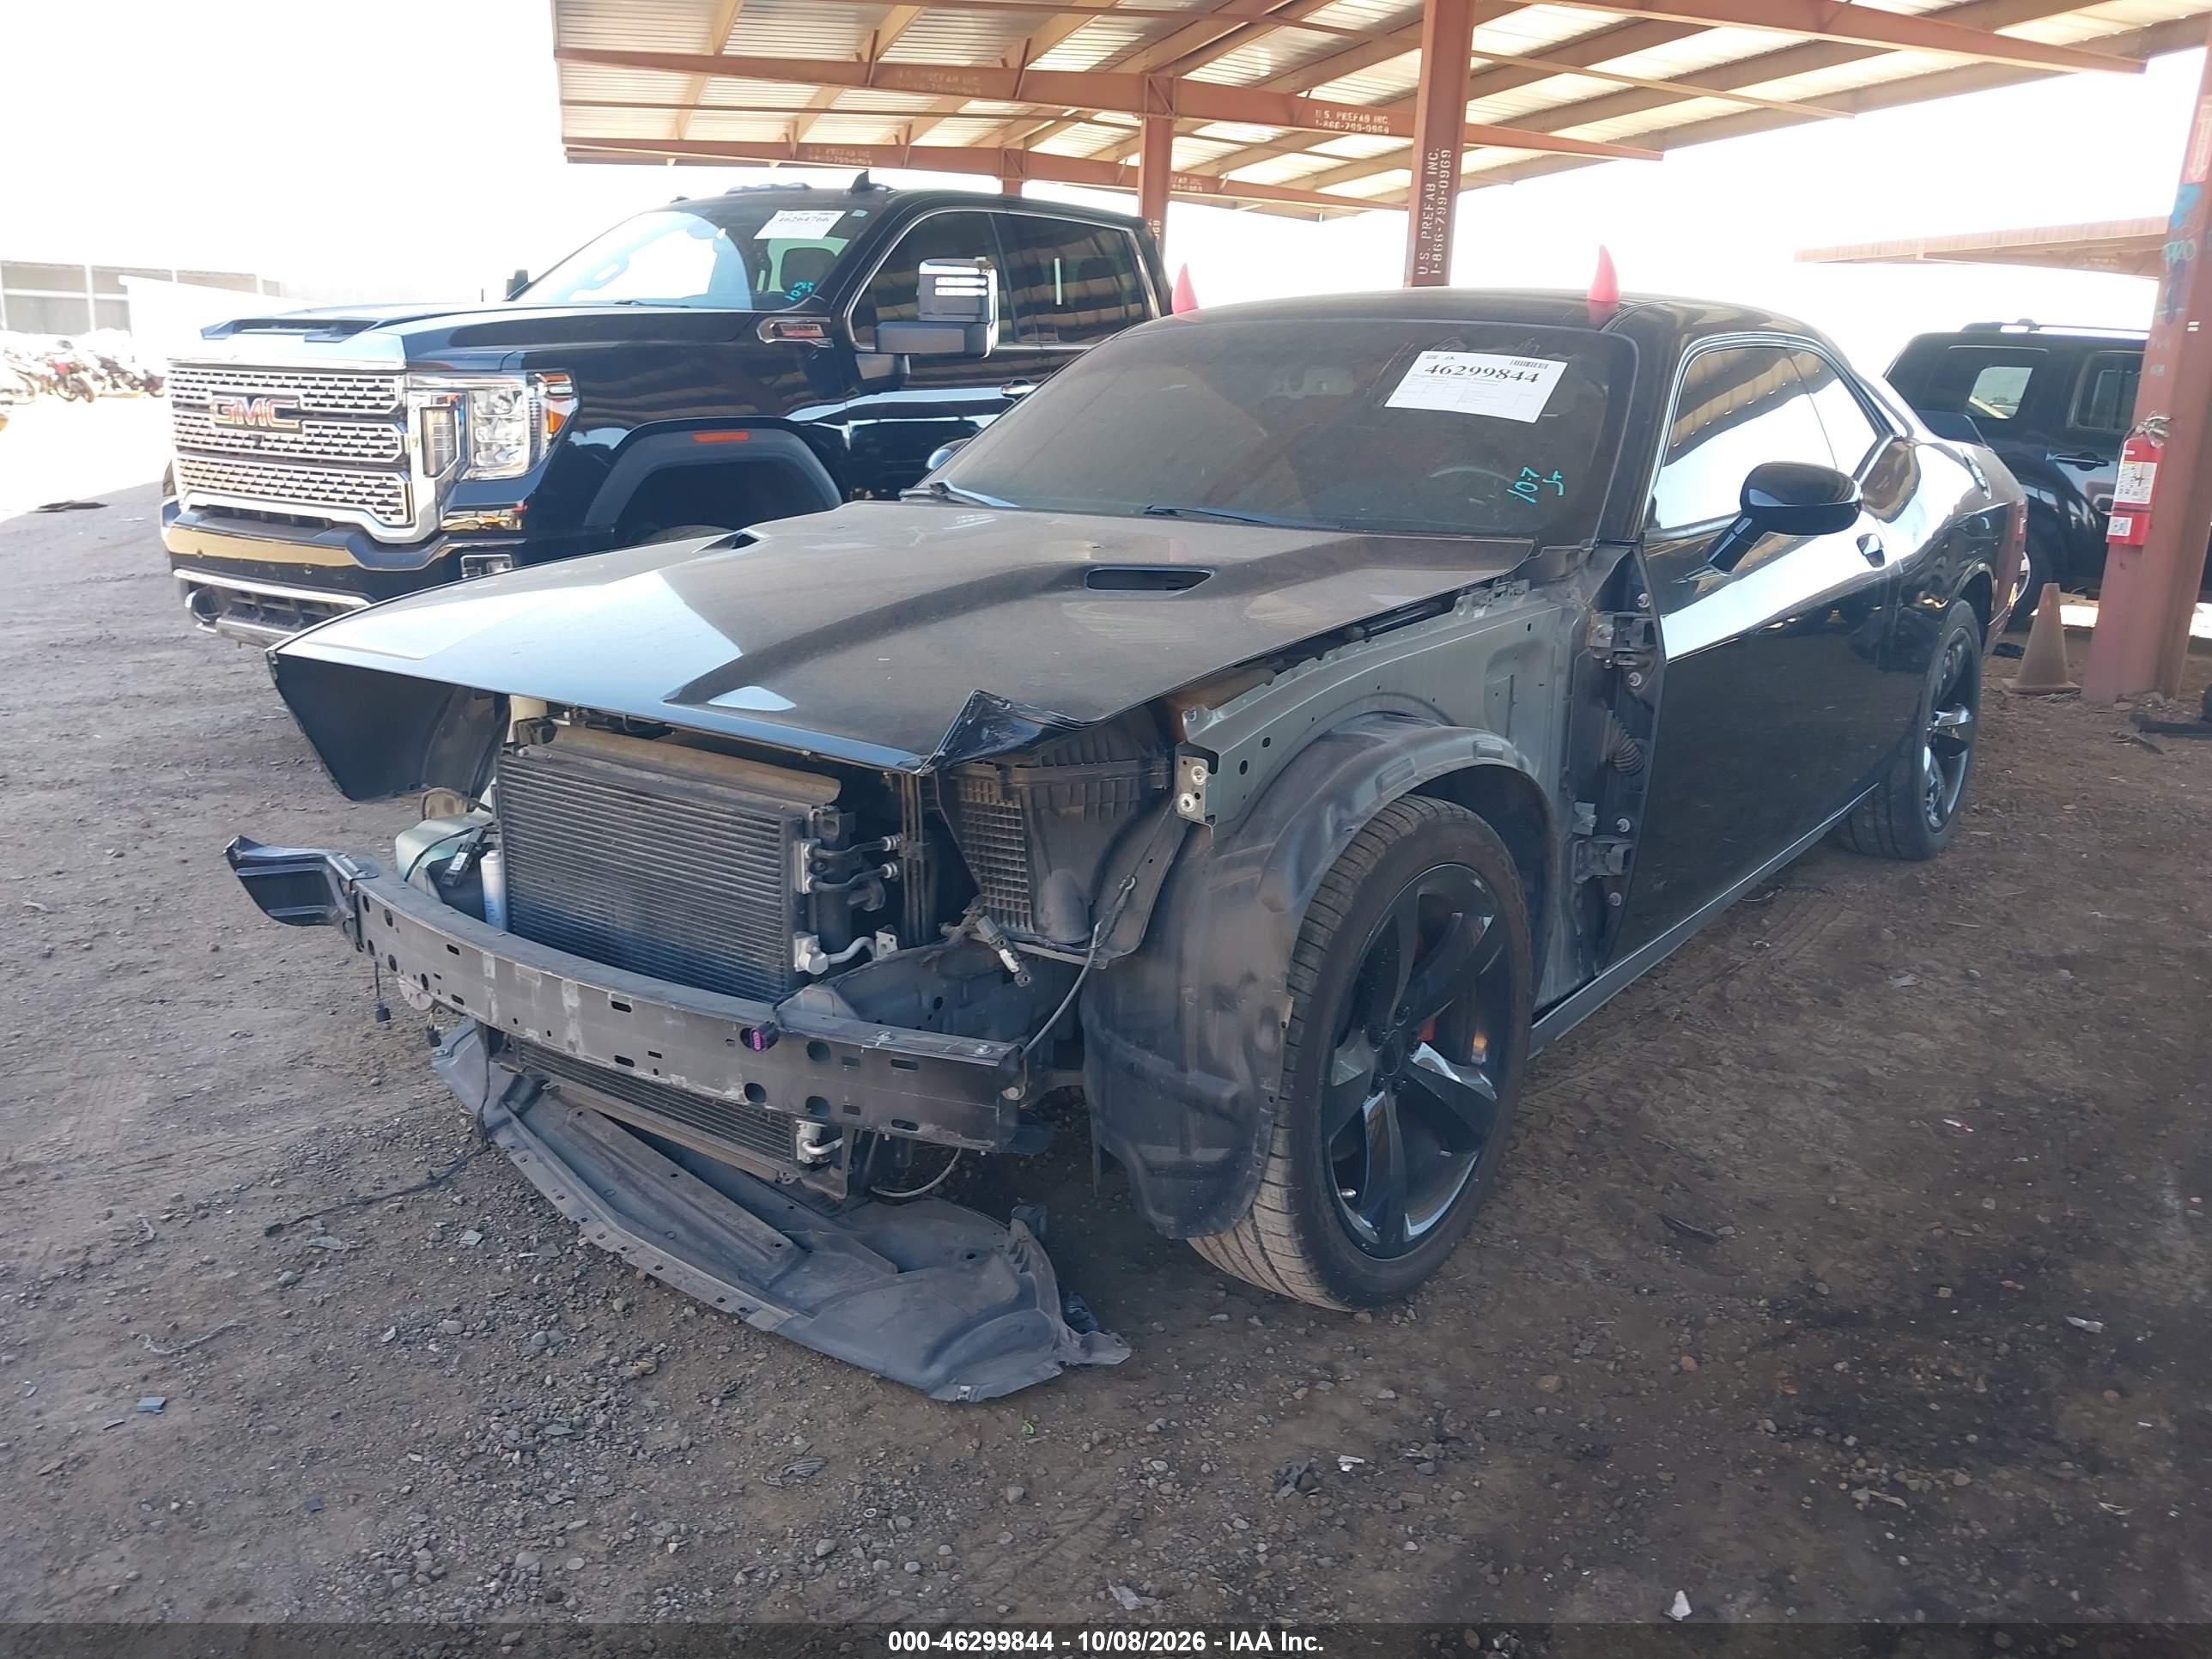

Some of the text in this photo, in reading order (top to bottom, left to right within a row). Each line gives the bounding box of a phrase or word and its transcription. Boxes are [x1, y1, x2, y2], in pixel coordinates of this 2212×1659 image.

[1336, 111, 1370, 123] PREFAB
[1418, 148, 1439, 275] U.S. PREFAB INC.
[1431, 149, 1452, 274] 1-866-799-0969
[1424, 363, 1540, 383] 46299844
[210, 394, 301, 428] GMC
